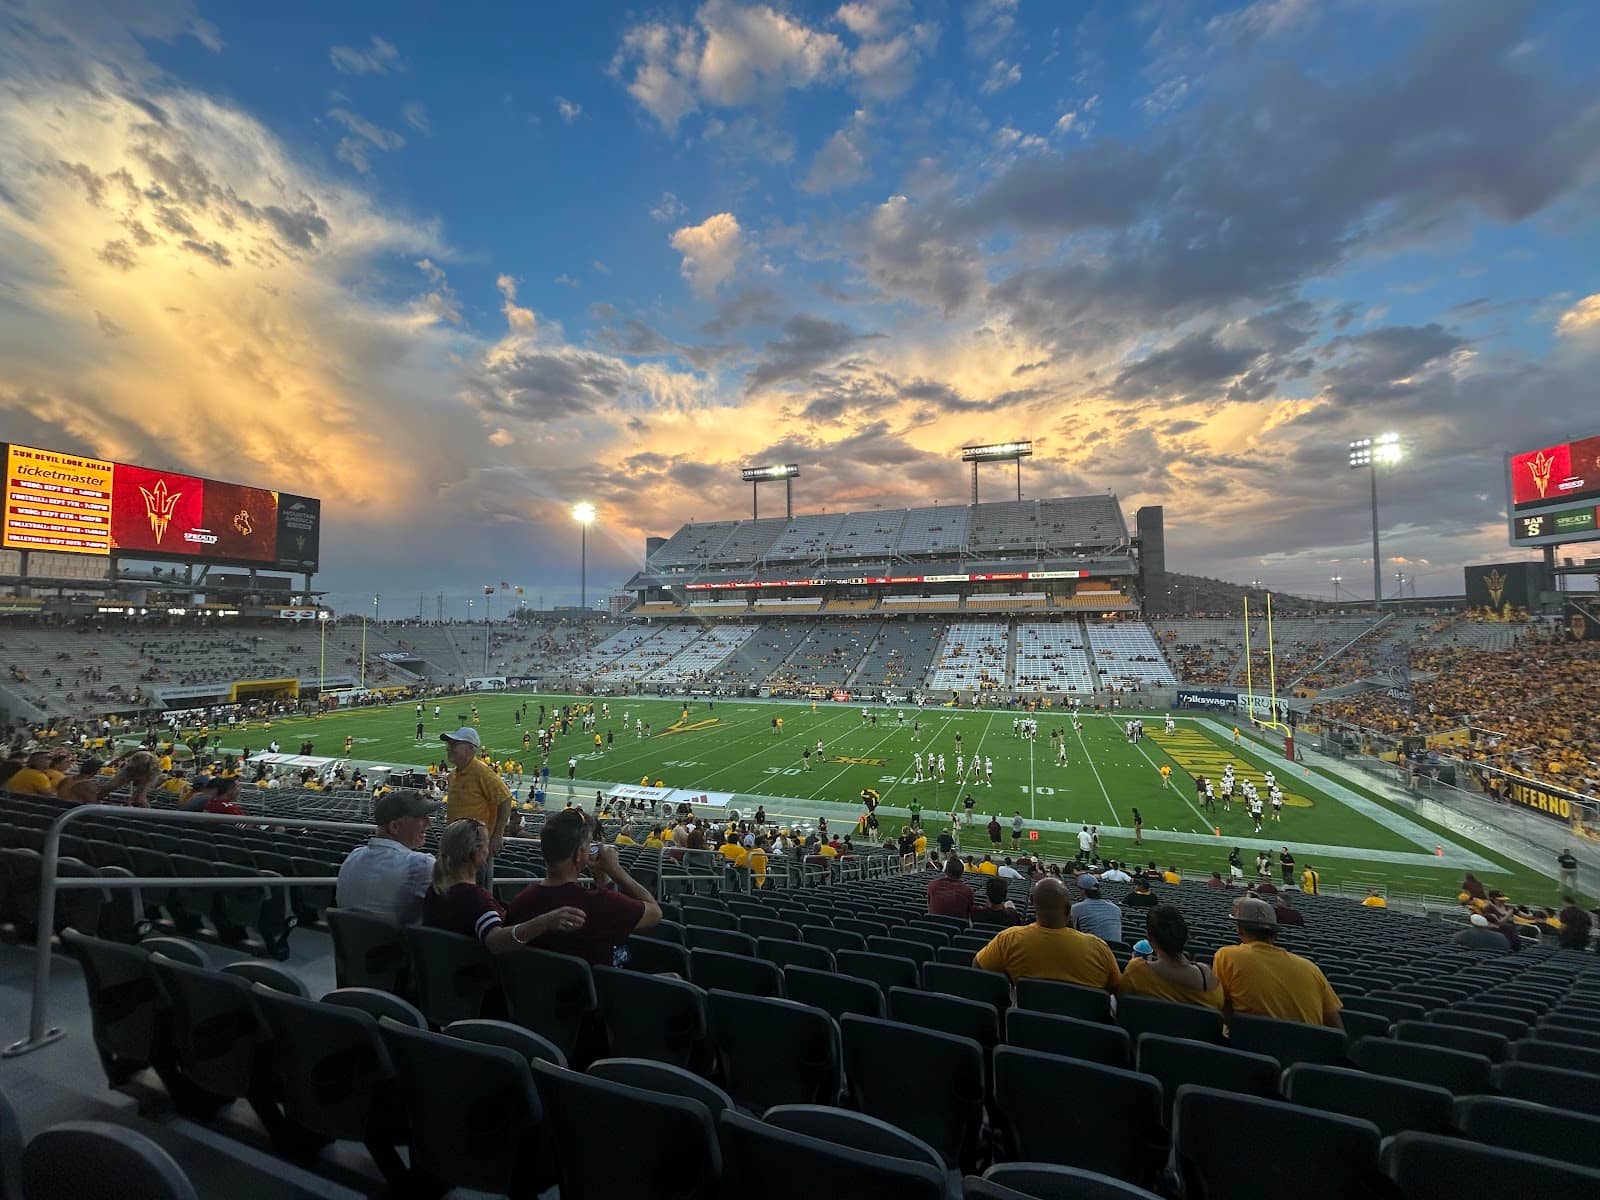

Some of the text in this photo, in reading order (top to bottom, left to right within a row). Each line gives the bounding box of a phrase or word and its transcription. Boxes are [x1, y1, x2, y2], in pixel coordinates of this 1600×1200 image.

[13, 450, 32, 458] SUN
[35, 453, 60, 463] DEVIL
[62, 458, 83, 467] LOOK
[85, 462, 112, 472] AHEAD
[17, 464, 106, 486] ticketmaster
[1528, 523, 1541, 537] S
[1020, 785, 1055, 795] 10
[1509, 783, 1570, 818] NFERNO
